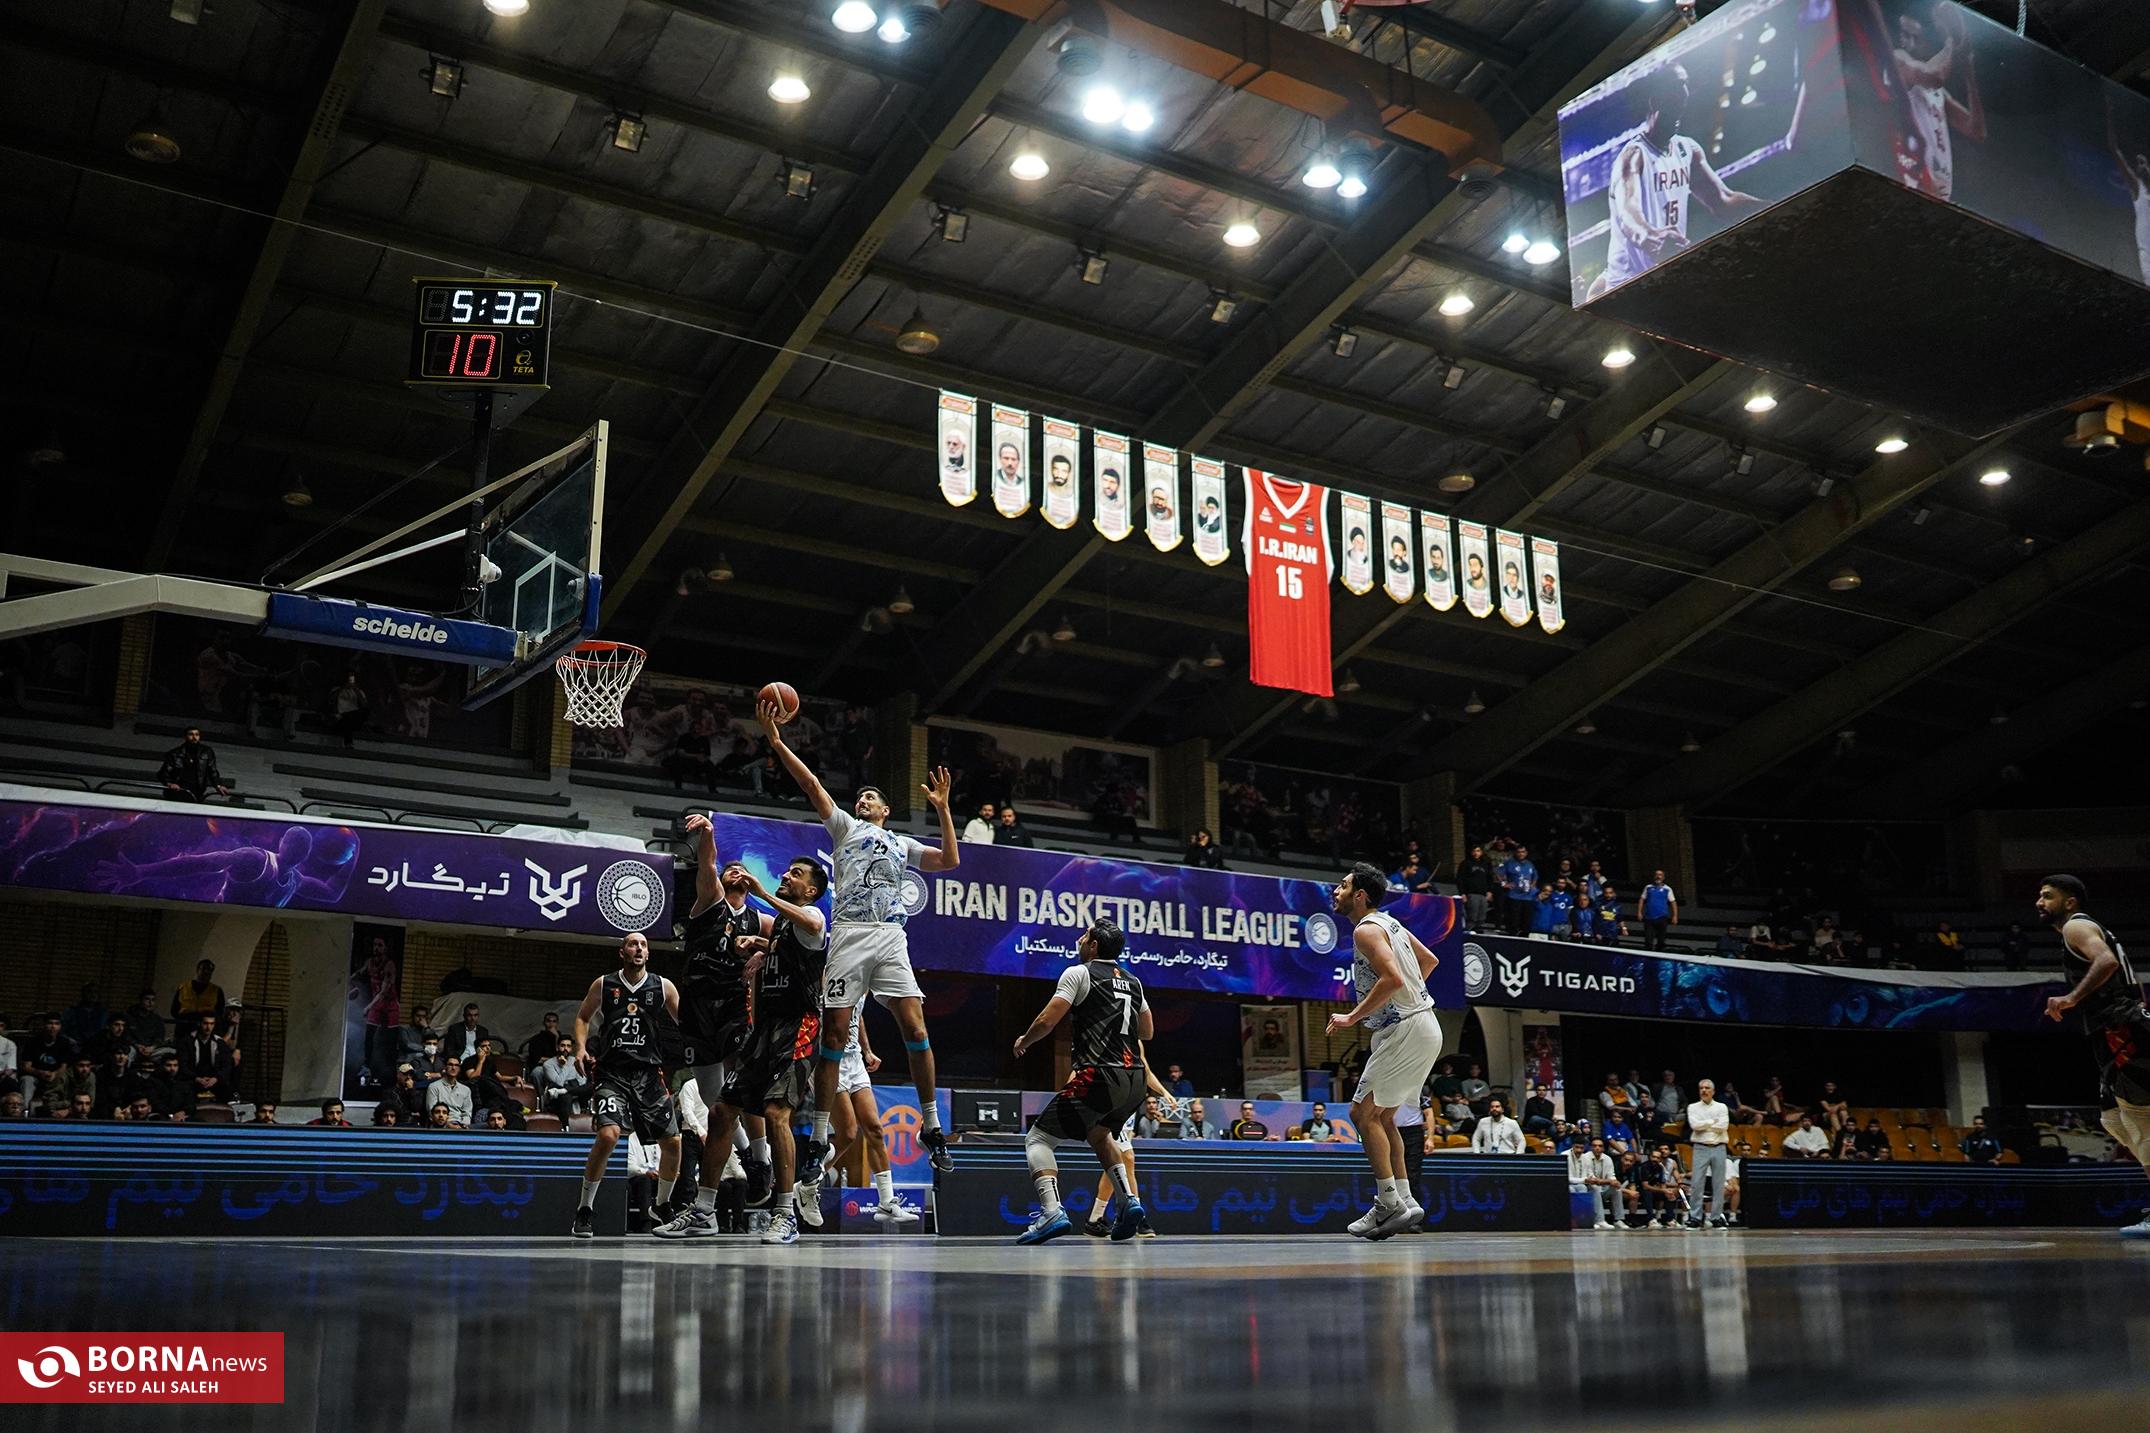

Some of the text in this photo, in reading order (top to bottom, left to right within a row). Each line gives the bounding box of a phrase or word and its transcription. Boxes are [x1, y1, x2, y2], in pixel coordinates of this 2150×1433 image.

[1653, 166, 1690, 193] IRAN
[1663, 199, 1679, 227] 15
[452, 289, 542, 325] 5:32
[448, 334, 497, 377] 10
[512, 366, 535, 374] TETA
[1258, 535, 1318, 565] I.R.IRAN
[1275, 564, 1304, 600] 15
[352, 616, 449, 644] schelde
[934, 878, 1301, 949] IRAN BASKETBALL LEAGUE
[1014, 935, 1065, 957] بسکتبال
[765, 954, 779, 975] 14
[827, 978, 847, 998] 23
[1111, 978, 1131, 992] AREN
[1538, 969, 1636, 994] TIGARD
[620, 1017, 641, 1035] 25
[1113, 991, 1132, 1036] 7
[684, 1046, 696, 1065] 9
[598, 1097, 618, 1115] 25
[1211, 1175, 1278, 1233] تیم
